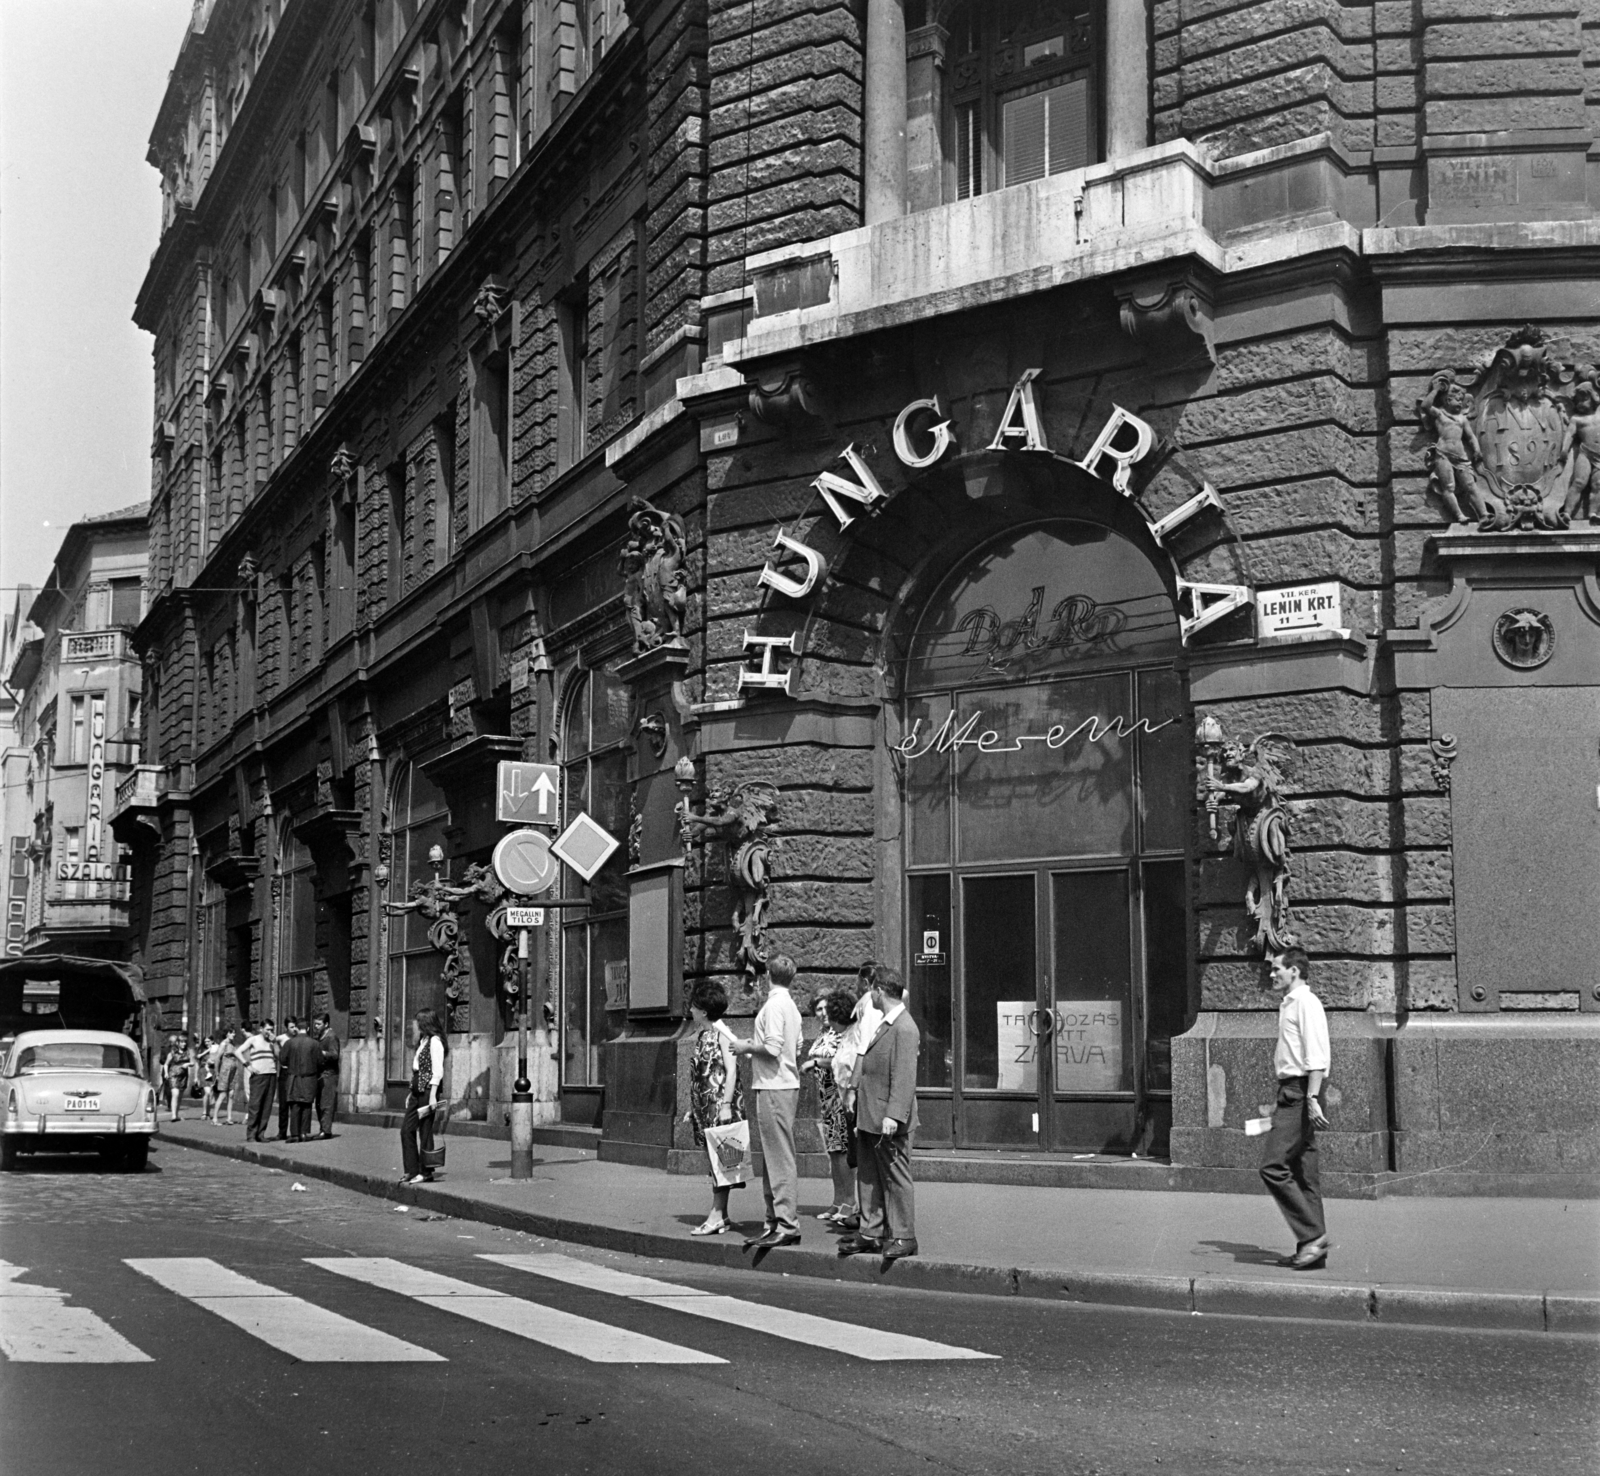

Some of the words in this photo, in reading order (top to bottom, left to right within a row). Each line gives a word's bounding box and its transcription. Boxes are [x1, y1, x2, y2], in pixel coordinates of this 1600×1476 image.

[1441, 169, 1507, 185] LENIN
[737, 367, 1256, 698] HUNGARIA
[1280, 591, 1297, 599] VII.
[1299, 589, 1319, 597] KER.
[1263, 599, 1302, 617] LENIN
[1308, 595, 1335, 612] KRT.
[1279, 617, 1290, 625] 11
[1312, 613, 1318, 621] 1
[1003, 1012, 1119, 1027] TATROZÁS
